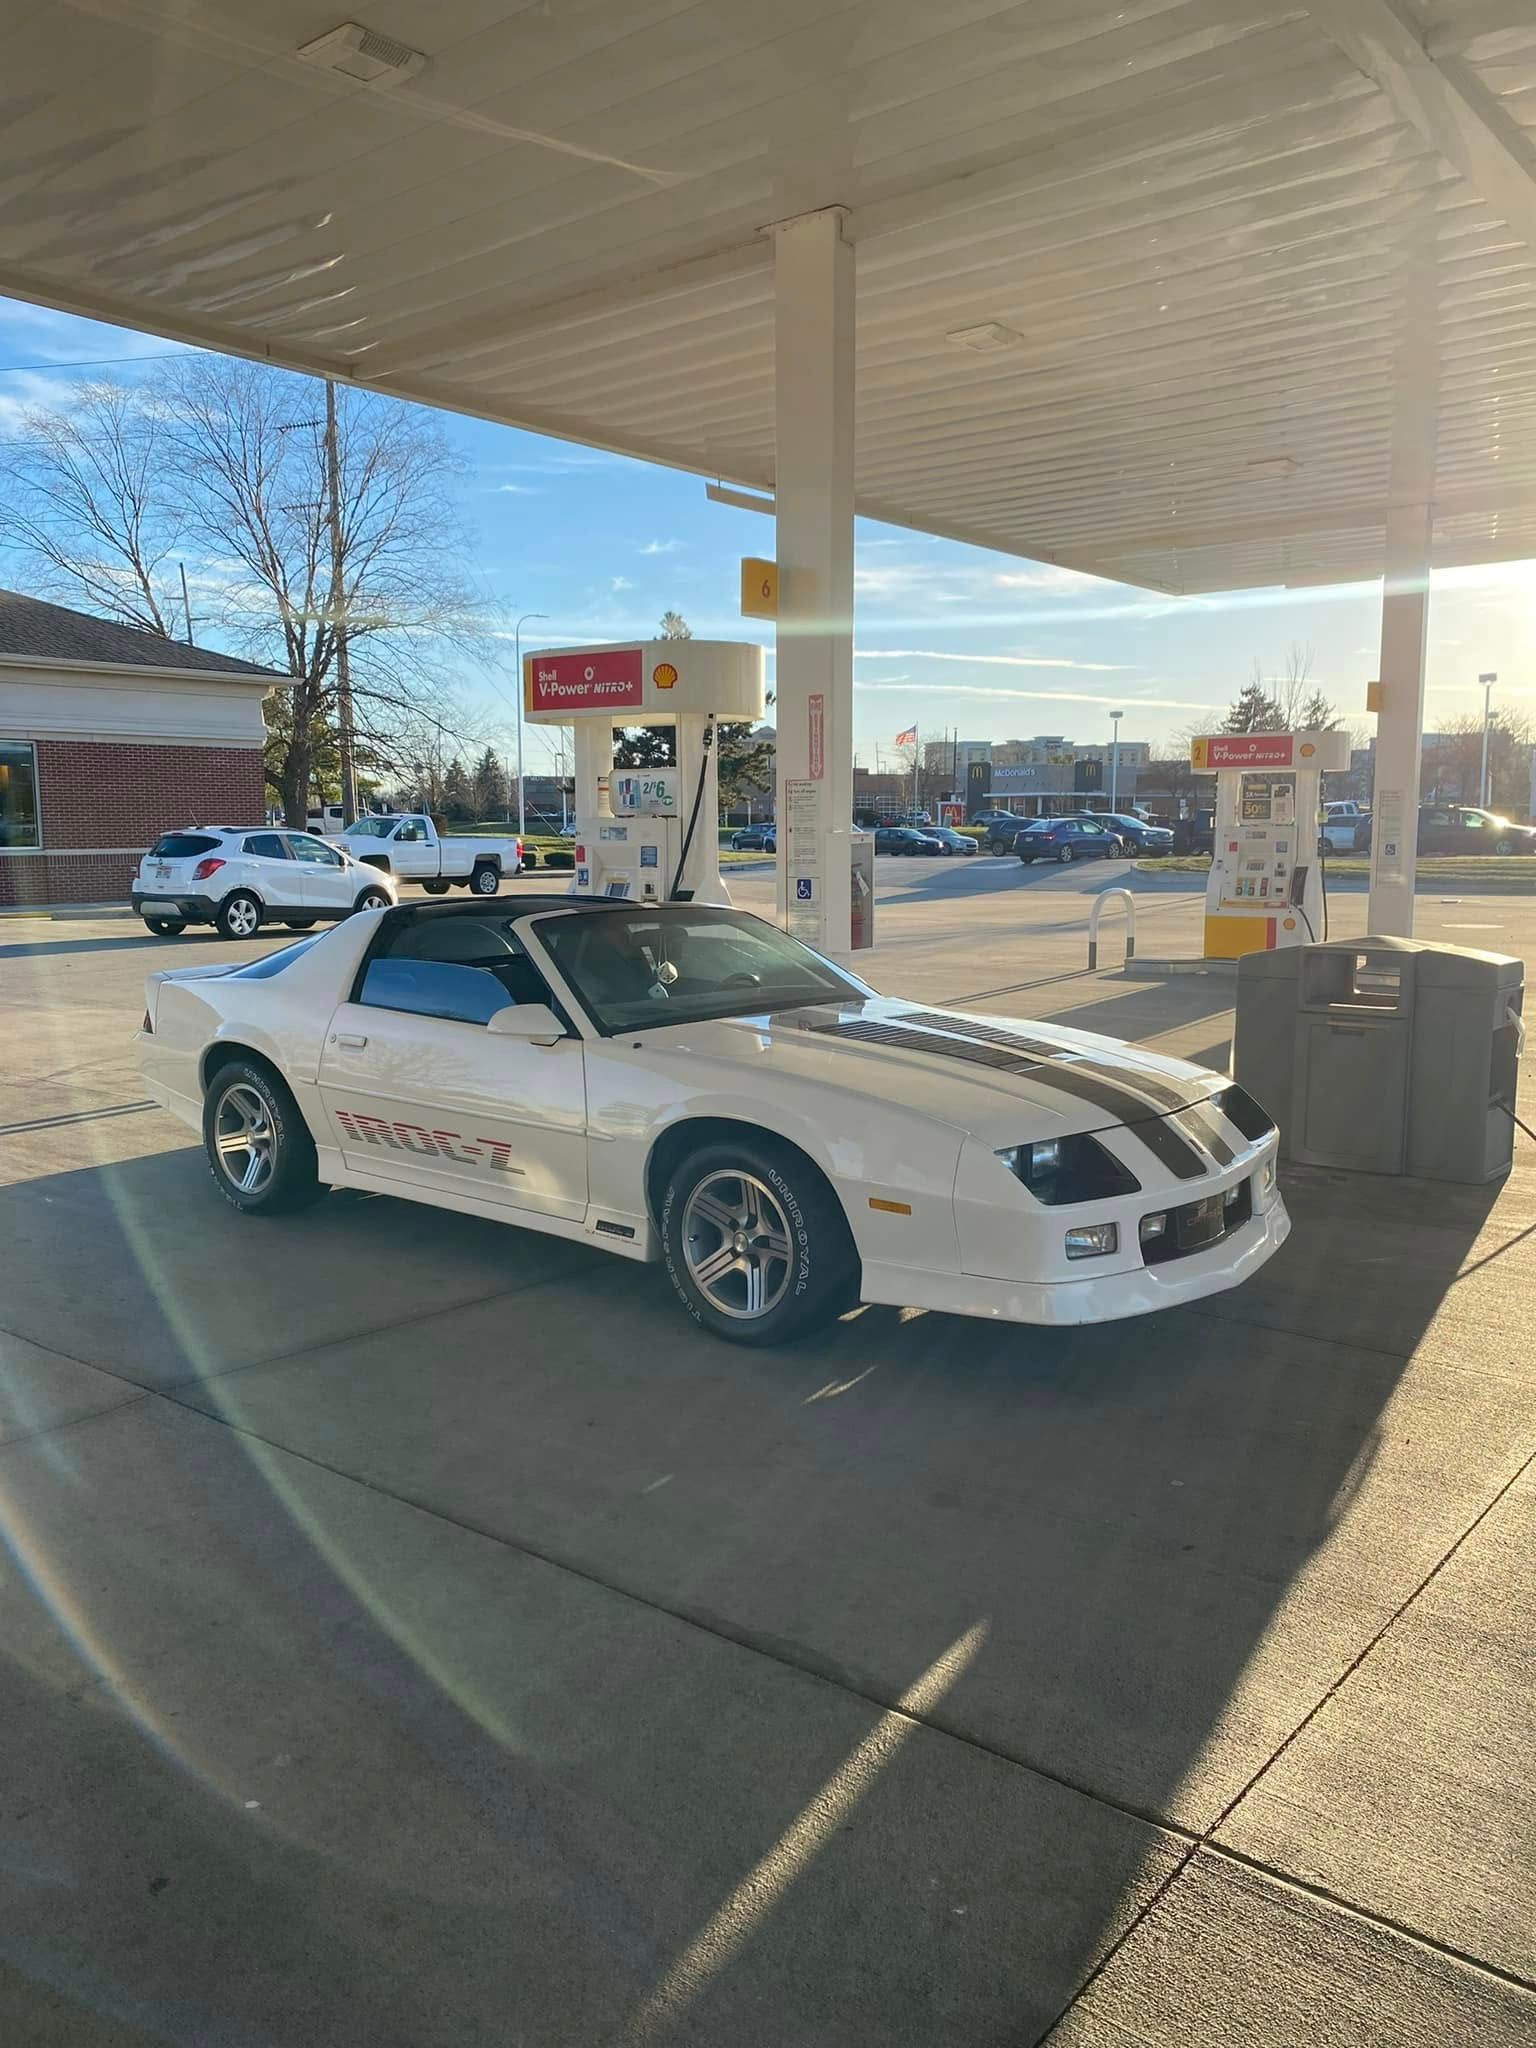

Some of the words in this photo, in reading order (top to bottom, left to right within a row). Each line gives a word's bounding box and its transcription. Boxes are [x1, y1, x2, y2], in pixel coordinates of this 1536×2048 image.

[761, 578, 771, 599] 6
[538, 669, 557, 681] Shell
[538, 682, 590, 697] V-Power
[1213, 751, 1252, 761] V-Power
[993, 766, 1036, 778] McDonald's
[336, 1111, 526, 1175] IROC-Z
[767, 1168, 812, 1297] UNIROYAL
